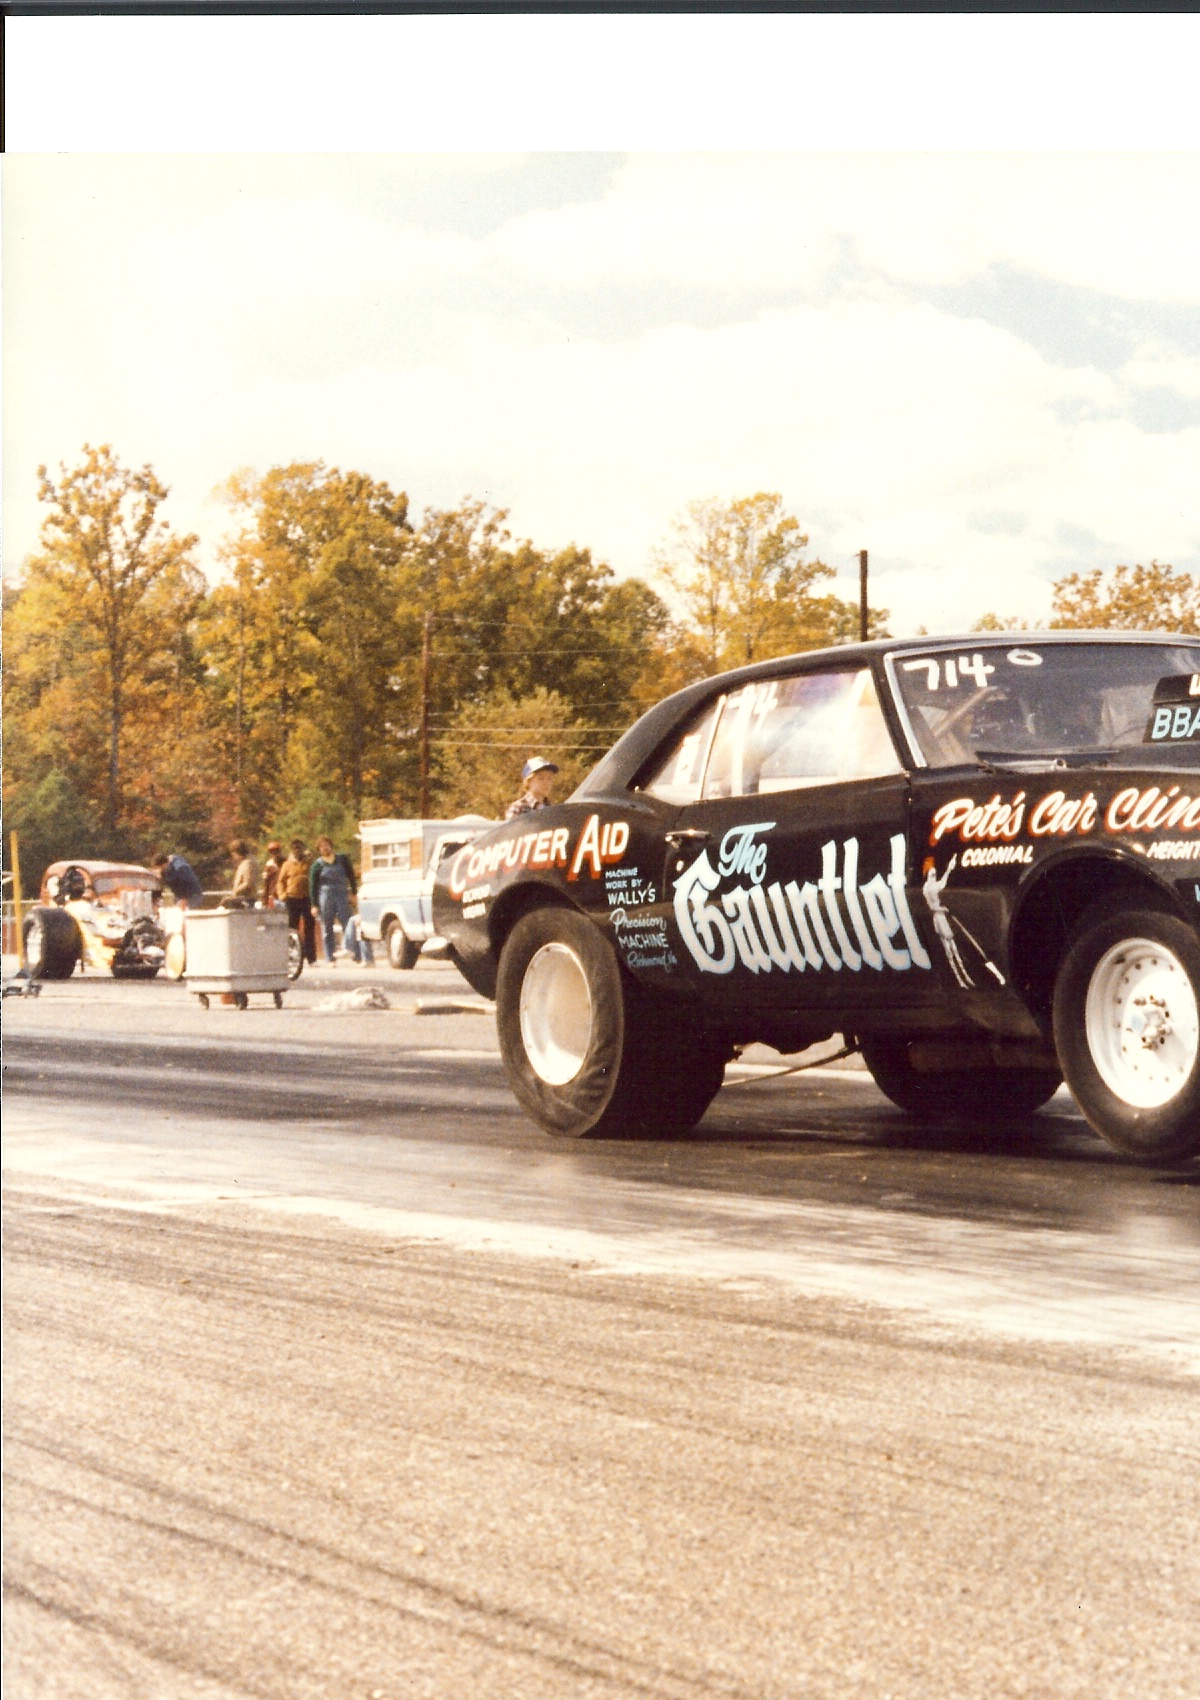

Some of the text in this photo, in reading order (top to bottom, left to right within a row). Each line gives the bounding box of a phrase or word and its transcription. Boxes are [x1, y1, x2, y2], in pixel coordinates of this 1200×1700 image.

[903, 653, 995, 691] 714
[930, 789, 1026, 844] Pete's
[1029, 790, 1098, 836] Car
[450, 814, 630, 897] COMPUTER AID
[718, 822, 777, 884] The
[961, 845, 1034, 867] COLONIAL
[605, 867, 638, 878] MACHINE
[605, 878, 642, 889] WORK BY
[607, 881, 656, 905] WALLY'S
[673, 833, 931, 974] Gauntlet
[609, 907, 667, 935] Precision
[618, 932, 669, 949] MACHINE
